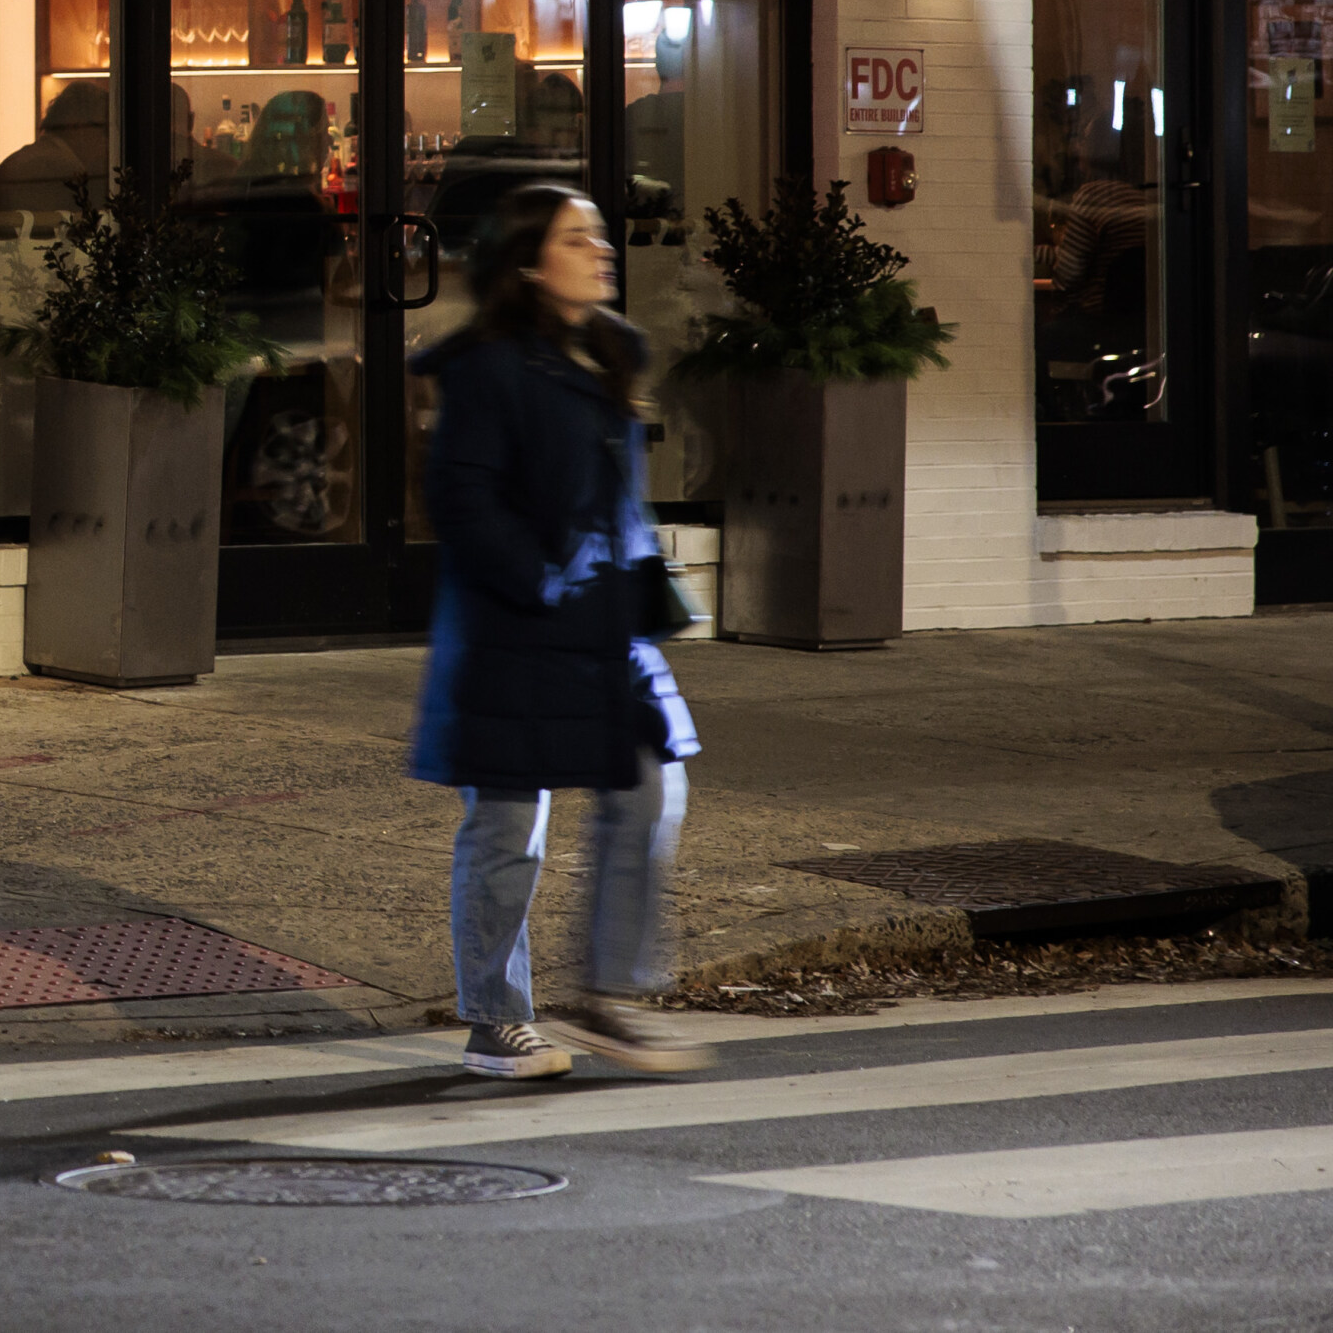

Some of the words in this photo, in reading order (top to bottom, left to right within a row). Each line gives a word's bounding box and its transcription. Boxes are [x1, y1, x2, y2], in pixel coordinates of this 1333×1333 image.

[851, 57, 918, 101] FDC
[850, 108, 880, 122] ENTIRE
[881, 108, 920, 123] BUILDING
